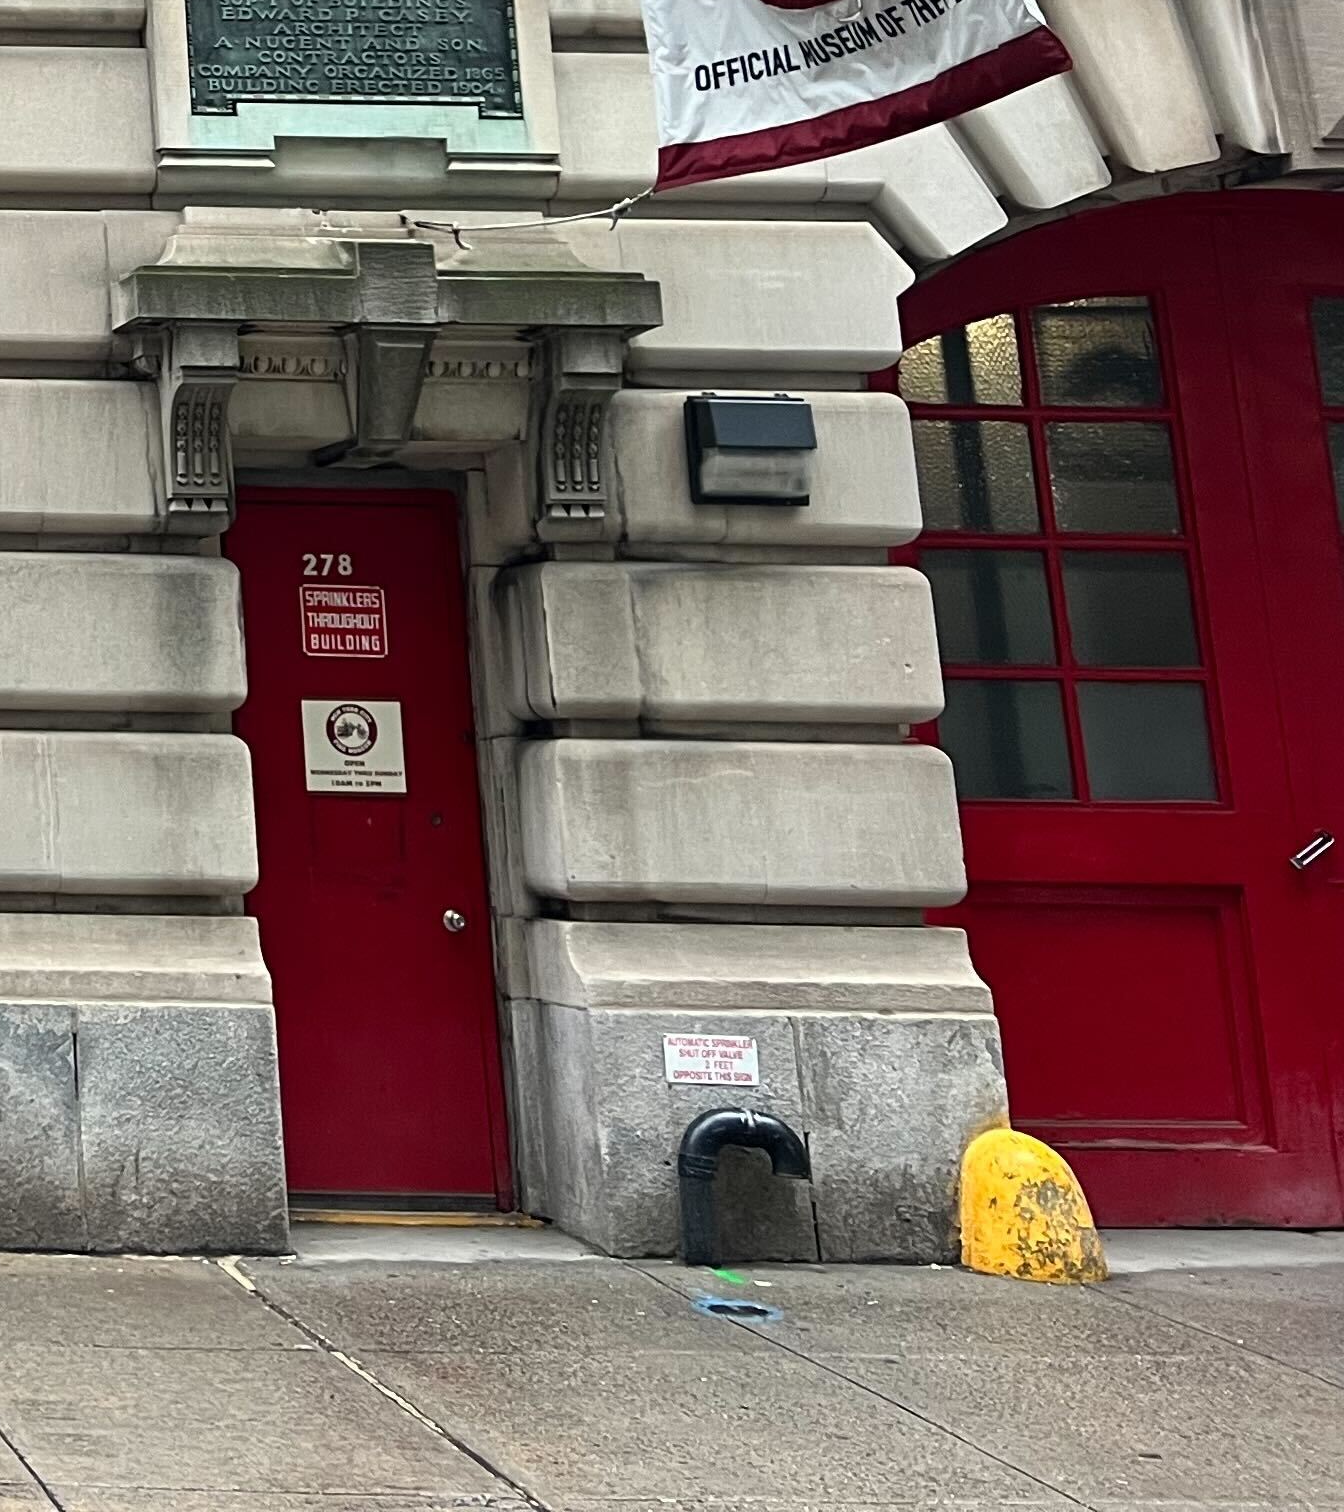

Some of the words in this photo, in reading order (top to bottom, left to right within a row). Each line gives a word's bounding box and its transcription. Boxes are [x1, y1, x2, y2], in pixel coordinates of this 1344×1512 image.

[221, 6, 333, 21] EDWARD
[273, 22, 423, 37] ARCHITECT
[362, 37, 421, 51] AND
[695, 43, 802, 92] OFFICIAL
[798, 18, 884, 70] MUSEUM
[877, 5, 907, 38] OF
[198, 63, 312, 78] COMPANY
[324, 65, 458, 79] ORGANIZED
[208, 78, 319, 92] BUILDING
[330, 79, 442, 94] ERECTED
[302, 553, 353, 576] 278
[305, 591, 380, 608] SPRINKLERS
[307, 612, 381, 629] THROUGHOUT
[310, 634, 380, 651] BUILDING
[668, 1038, 709, 1047] AUTOMATIC
[679, 1048, 699, 1058] SHUT
[701, 1049, 717, 1058] OFF
[718, 1050, 744, 1060] VALVE
[714, 1060, 733, 1070] FEET
[673, 1070, 712, 1080] OPPOSITE
[714, 1071, 732, 1081] THIS
[734, 1072, 752, 1081] SIGN
